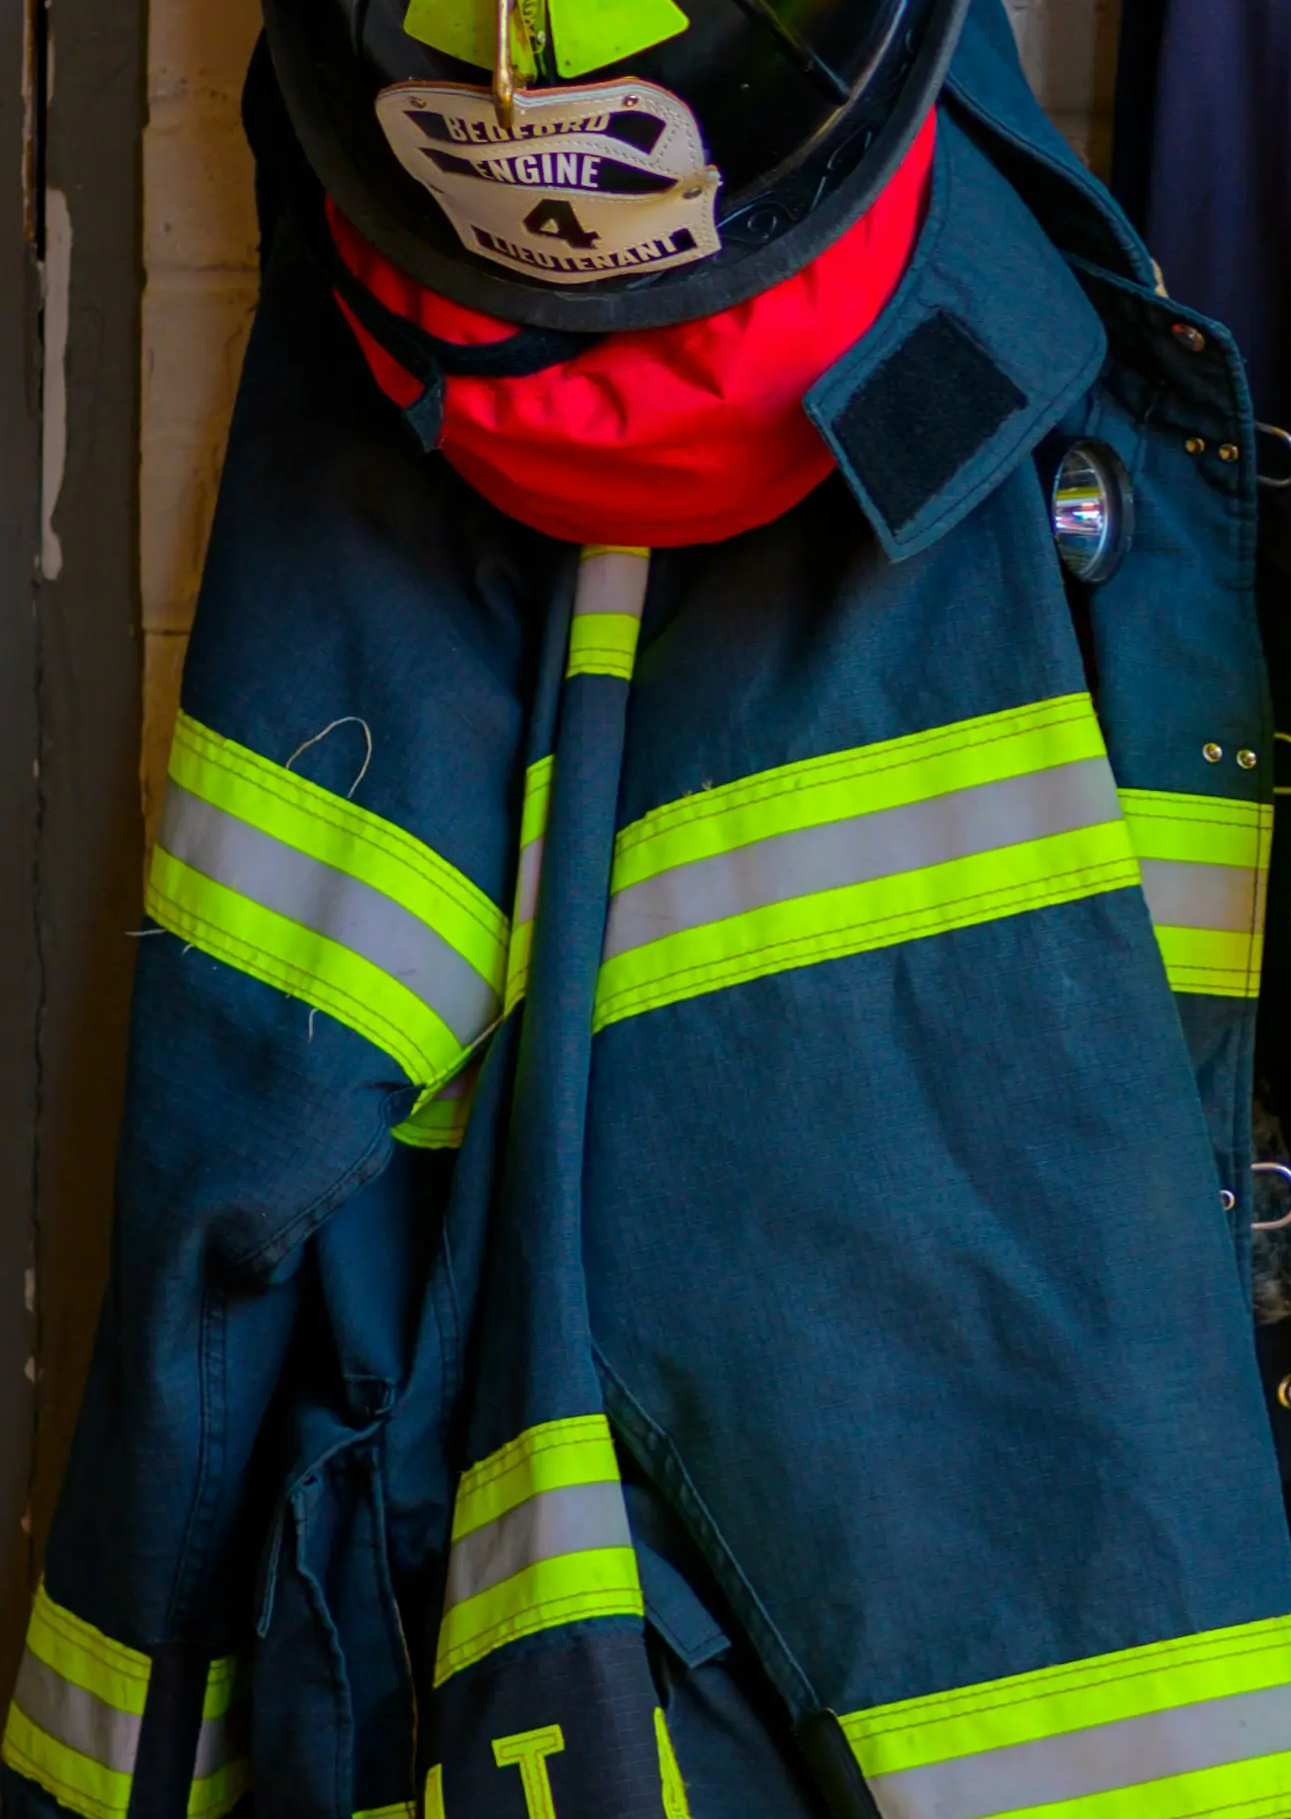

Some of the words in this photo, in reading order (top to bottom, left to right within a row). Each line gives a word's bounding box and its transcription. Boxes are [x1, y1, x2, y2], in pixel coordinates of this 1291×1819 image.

[478, 153, 601, 188] ENGINE
[522, 198, 602, 250] 4
[497, 235, 678, 272] LIEUTENANT
